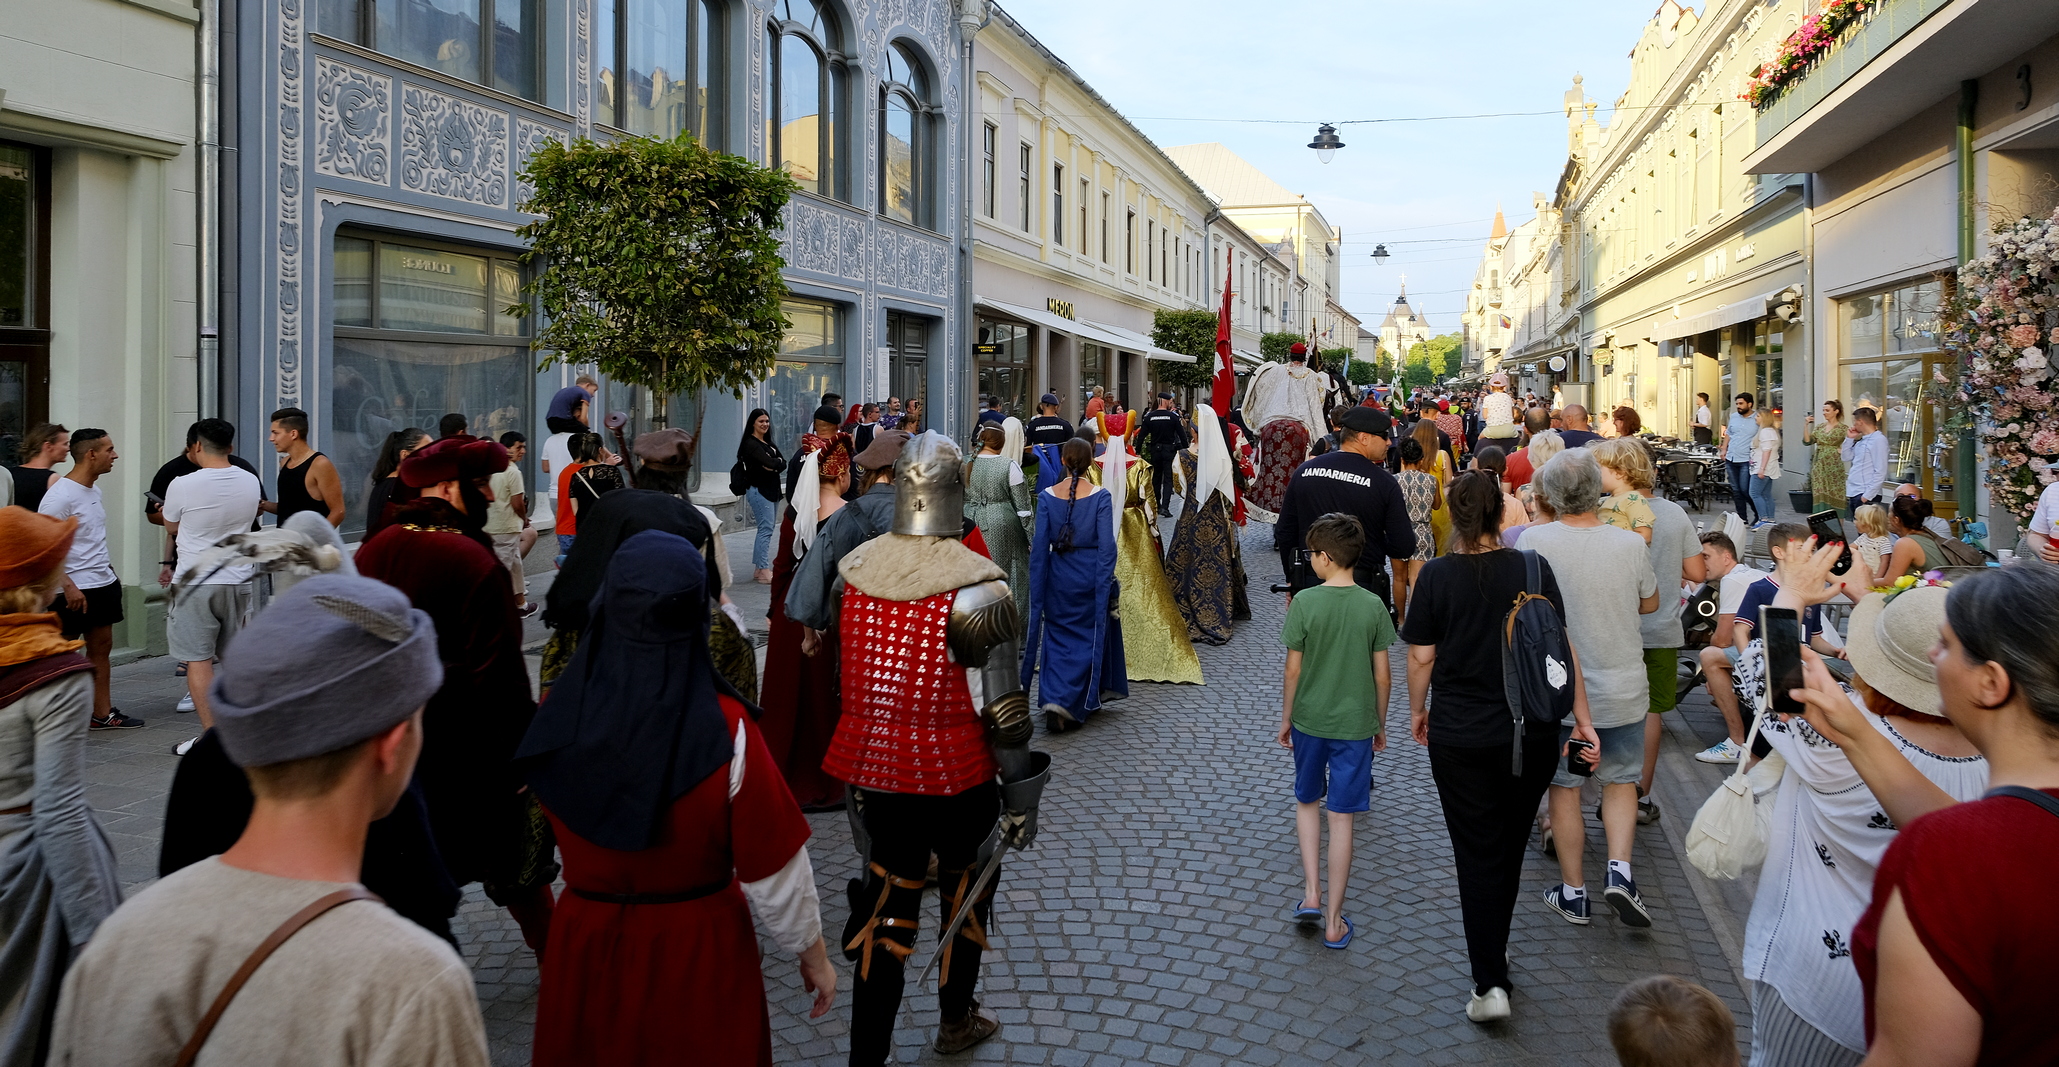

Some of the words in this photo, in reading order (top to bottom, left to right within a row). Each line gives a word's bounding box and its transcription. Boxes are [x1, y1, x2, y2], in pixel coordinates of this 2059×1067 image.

[2014, 64, 2033, 109] 3
[1048, 298, 1075, 321] MERON
[1302, 468, 1371, 488] JANDARMERIA
